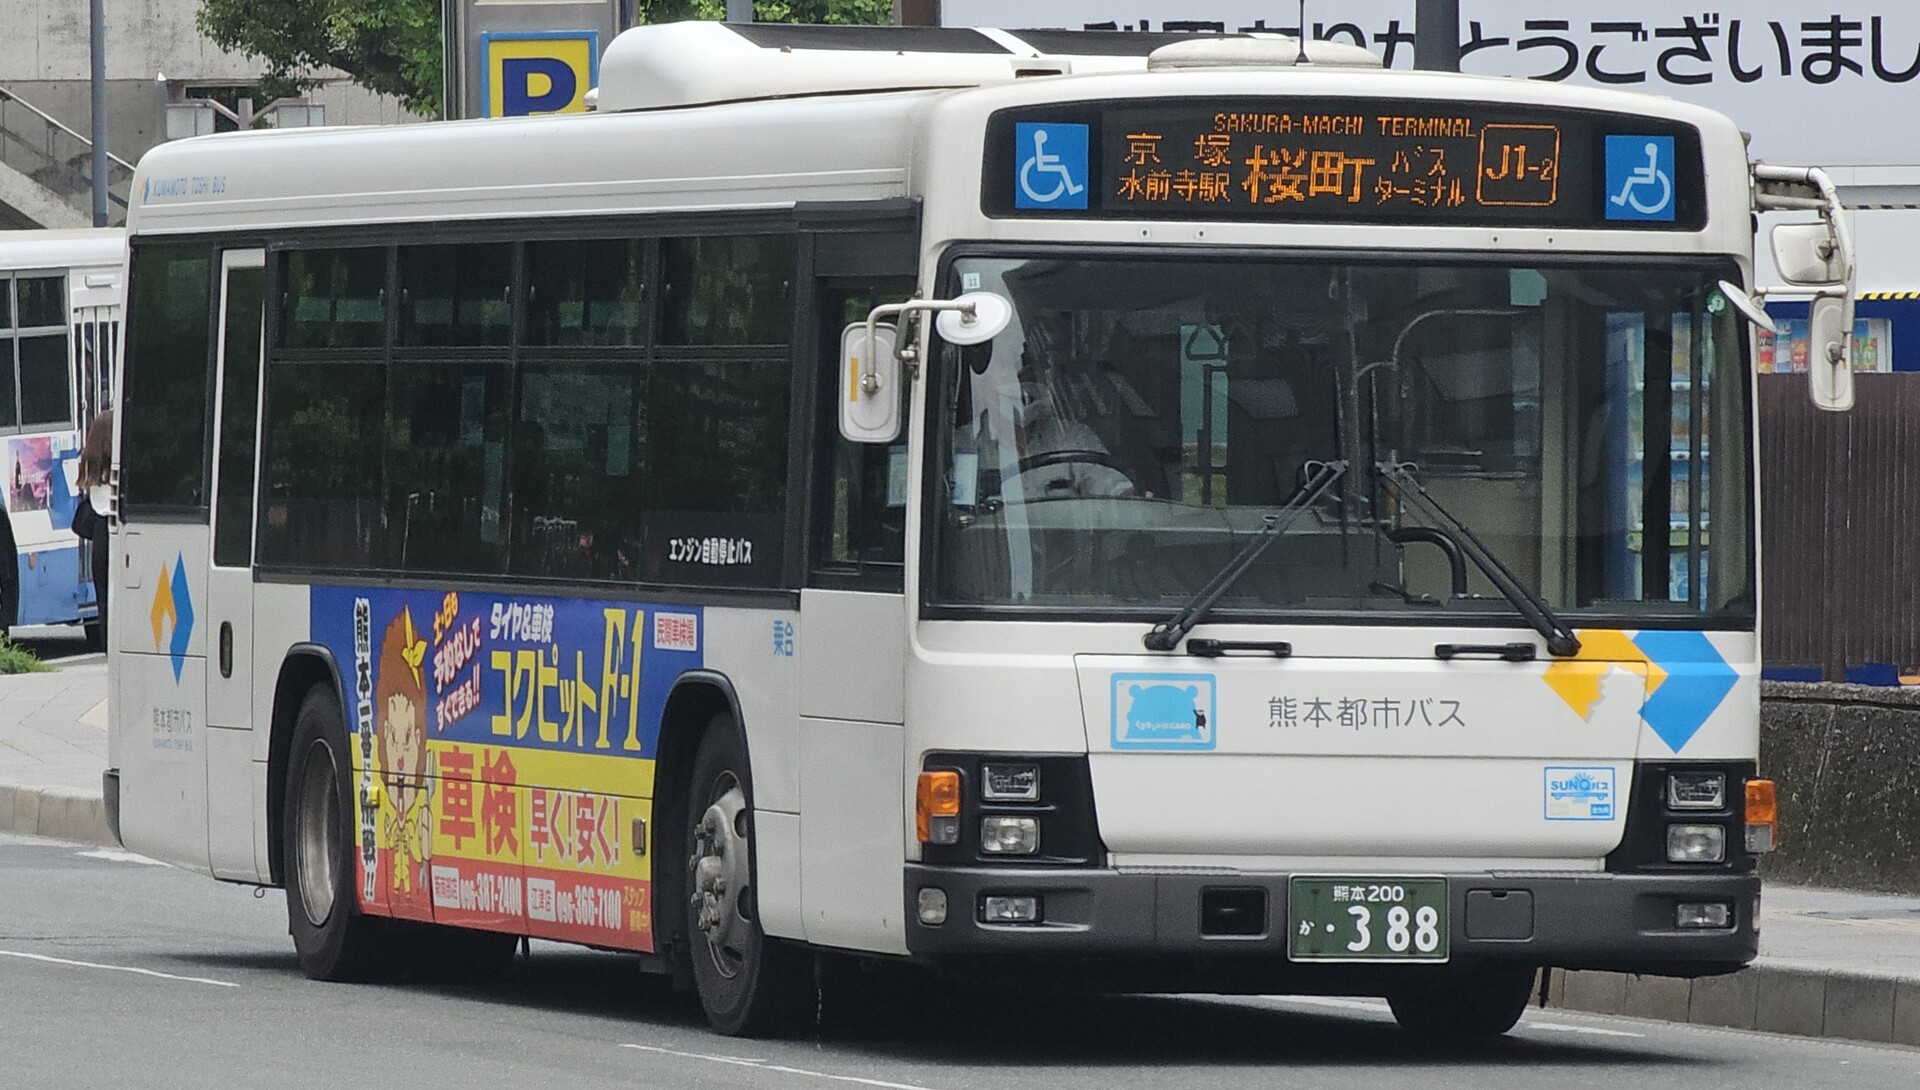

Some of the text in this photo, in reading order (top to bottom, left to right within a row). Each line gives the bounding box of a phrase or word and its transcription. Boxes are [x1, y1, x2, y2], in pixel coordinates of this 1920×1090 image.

[502, 58, 576, 117] P
[1214, 113, 1476, 138] SAKURA-MACHI TERMINAL
[1241, 144, 1376, 203] 桜町
[1486, 144, 1553, 181] J1-2
[1117, 167, 1231, 202] 水前寺駅
[1374, 175, 1466, 207] ターミナル
[669, 537, 753, 566] エンジン自動停止バス
[490, 602, 555, 643] タイヤ&車検
[773, 620, 794, 657] 乗合
[491, 608, 645, 751] コクピット F-1
[1268, 696, 1466, 731] 熊本都市バス
[440, 745, 519, 858] 車検
